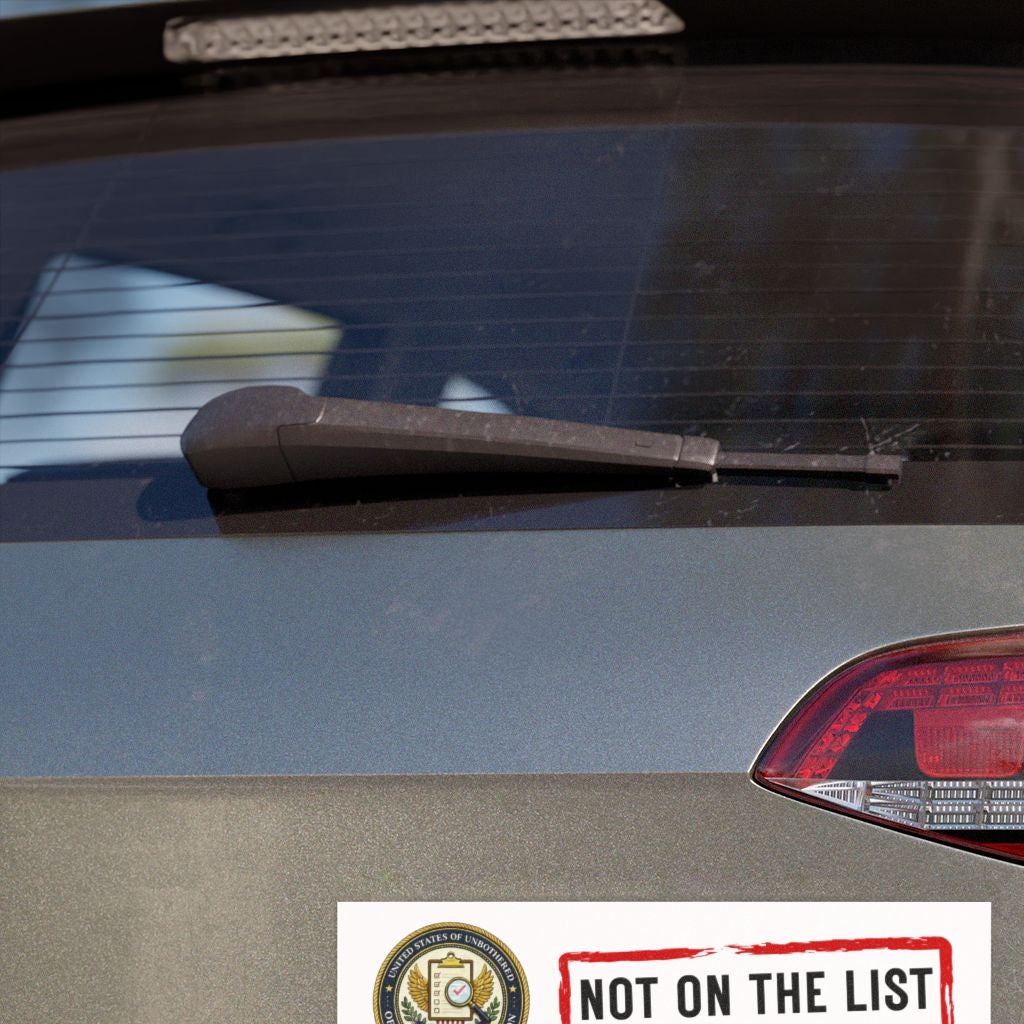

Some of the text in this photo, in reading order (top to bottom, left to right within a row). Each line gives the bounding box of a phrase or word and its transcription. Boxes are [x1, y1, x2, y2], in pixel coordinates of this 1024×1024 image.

[388, 932, 515, 982] UNITED STATES OF UNBOTHERED
[580, 967, 933, 1021] NOT ON THE LIST
